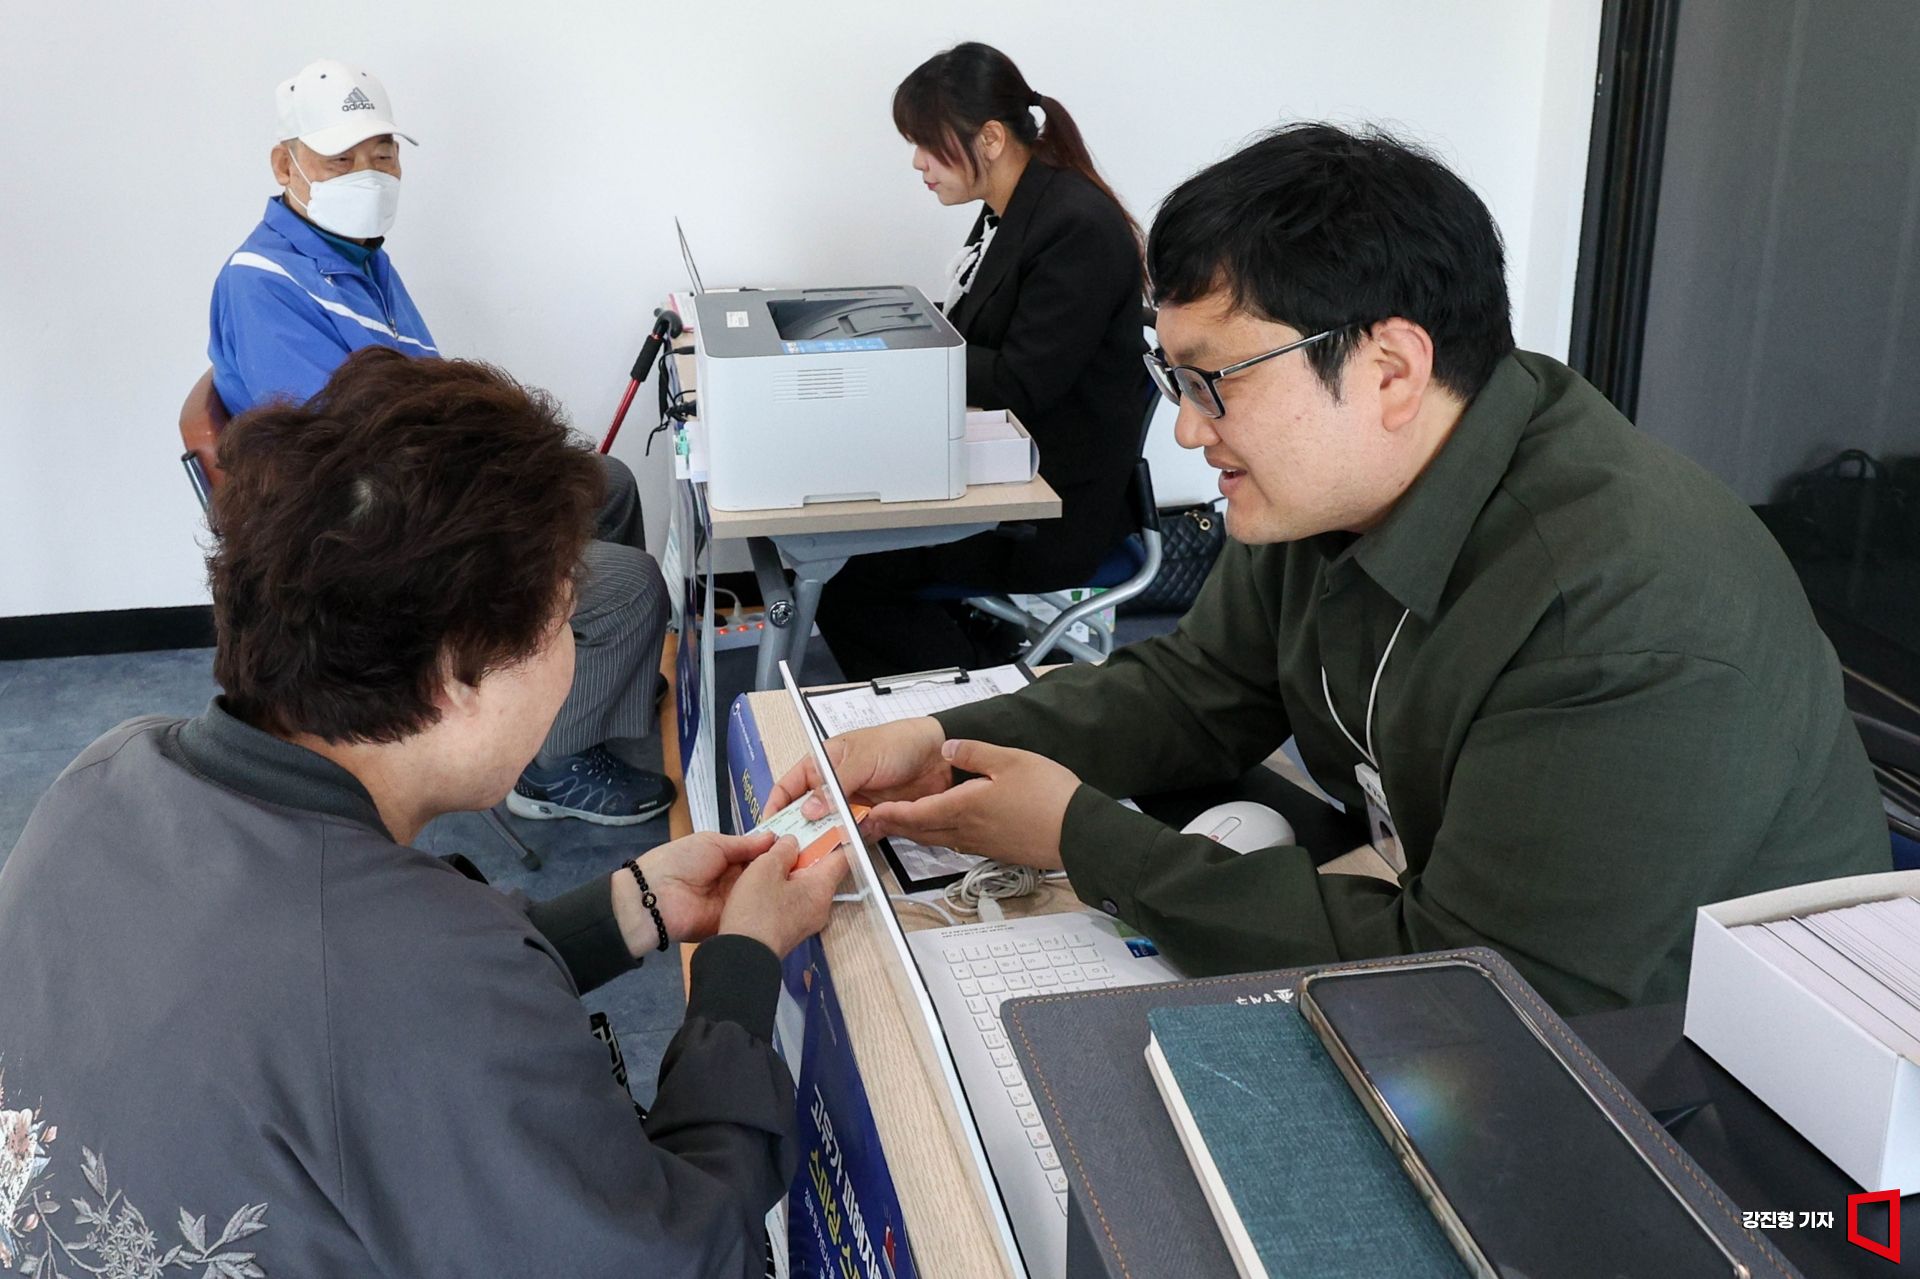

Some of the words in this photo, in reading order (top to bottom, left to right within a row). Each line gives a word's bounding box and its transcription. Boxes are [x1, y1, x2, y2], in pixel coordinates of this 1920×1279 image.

[342, 101, 375, 112] adidas
[808, 1150, 860, 1279] 스미싱·스
[810, 1083, 844, 1186] 고유가
[842, 1171, 882, 1279] 피해지
